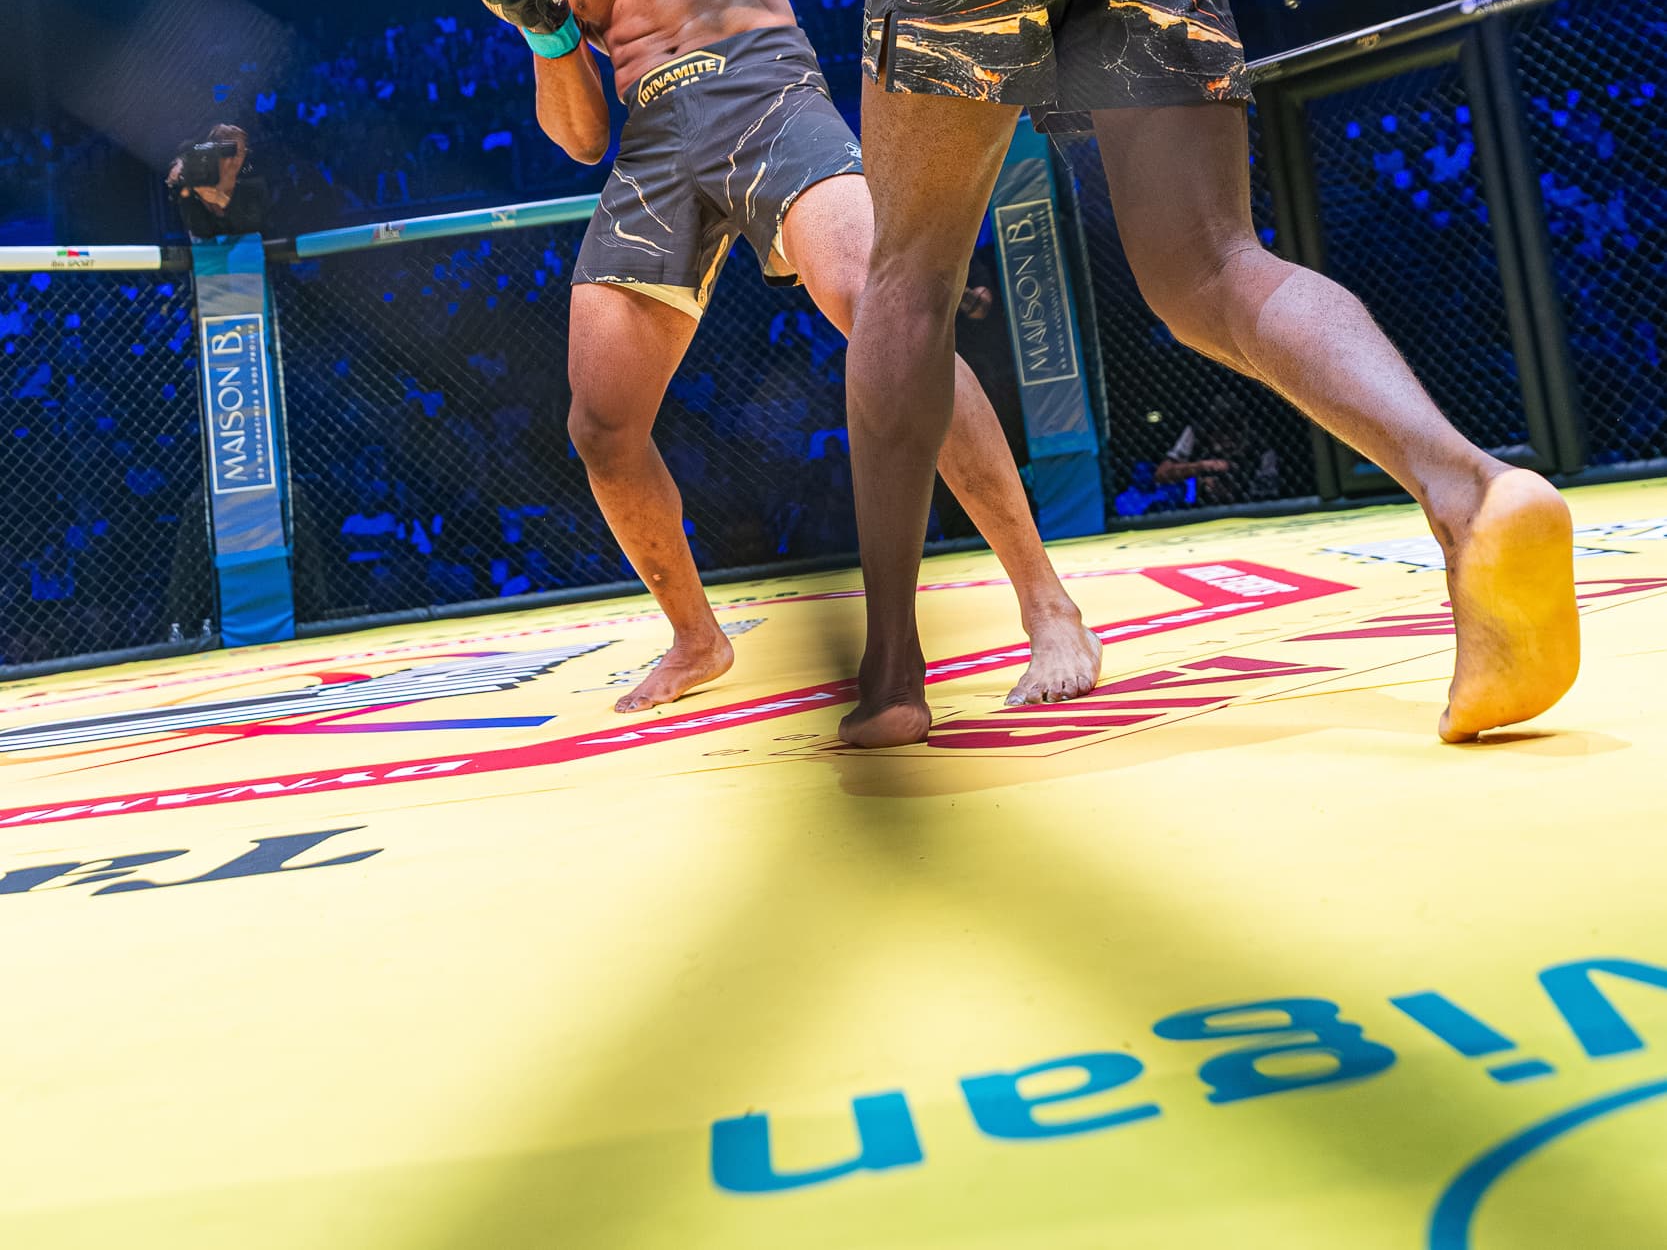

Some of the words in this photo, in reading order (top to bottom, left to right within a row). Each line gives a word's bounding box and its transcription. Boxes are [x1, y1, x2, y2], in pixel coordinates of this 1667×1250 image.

[640, 58, 717, 103] DYNAMITE
[211, 325, 243, 355] B.
[1012, 254, 1051, 372] MAISON
[216, 366, 249, 481] MAISON
[710, 958, 1667, 1195] Vigan
